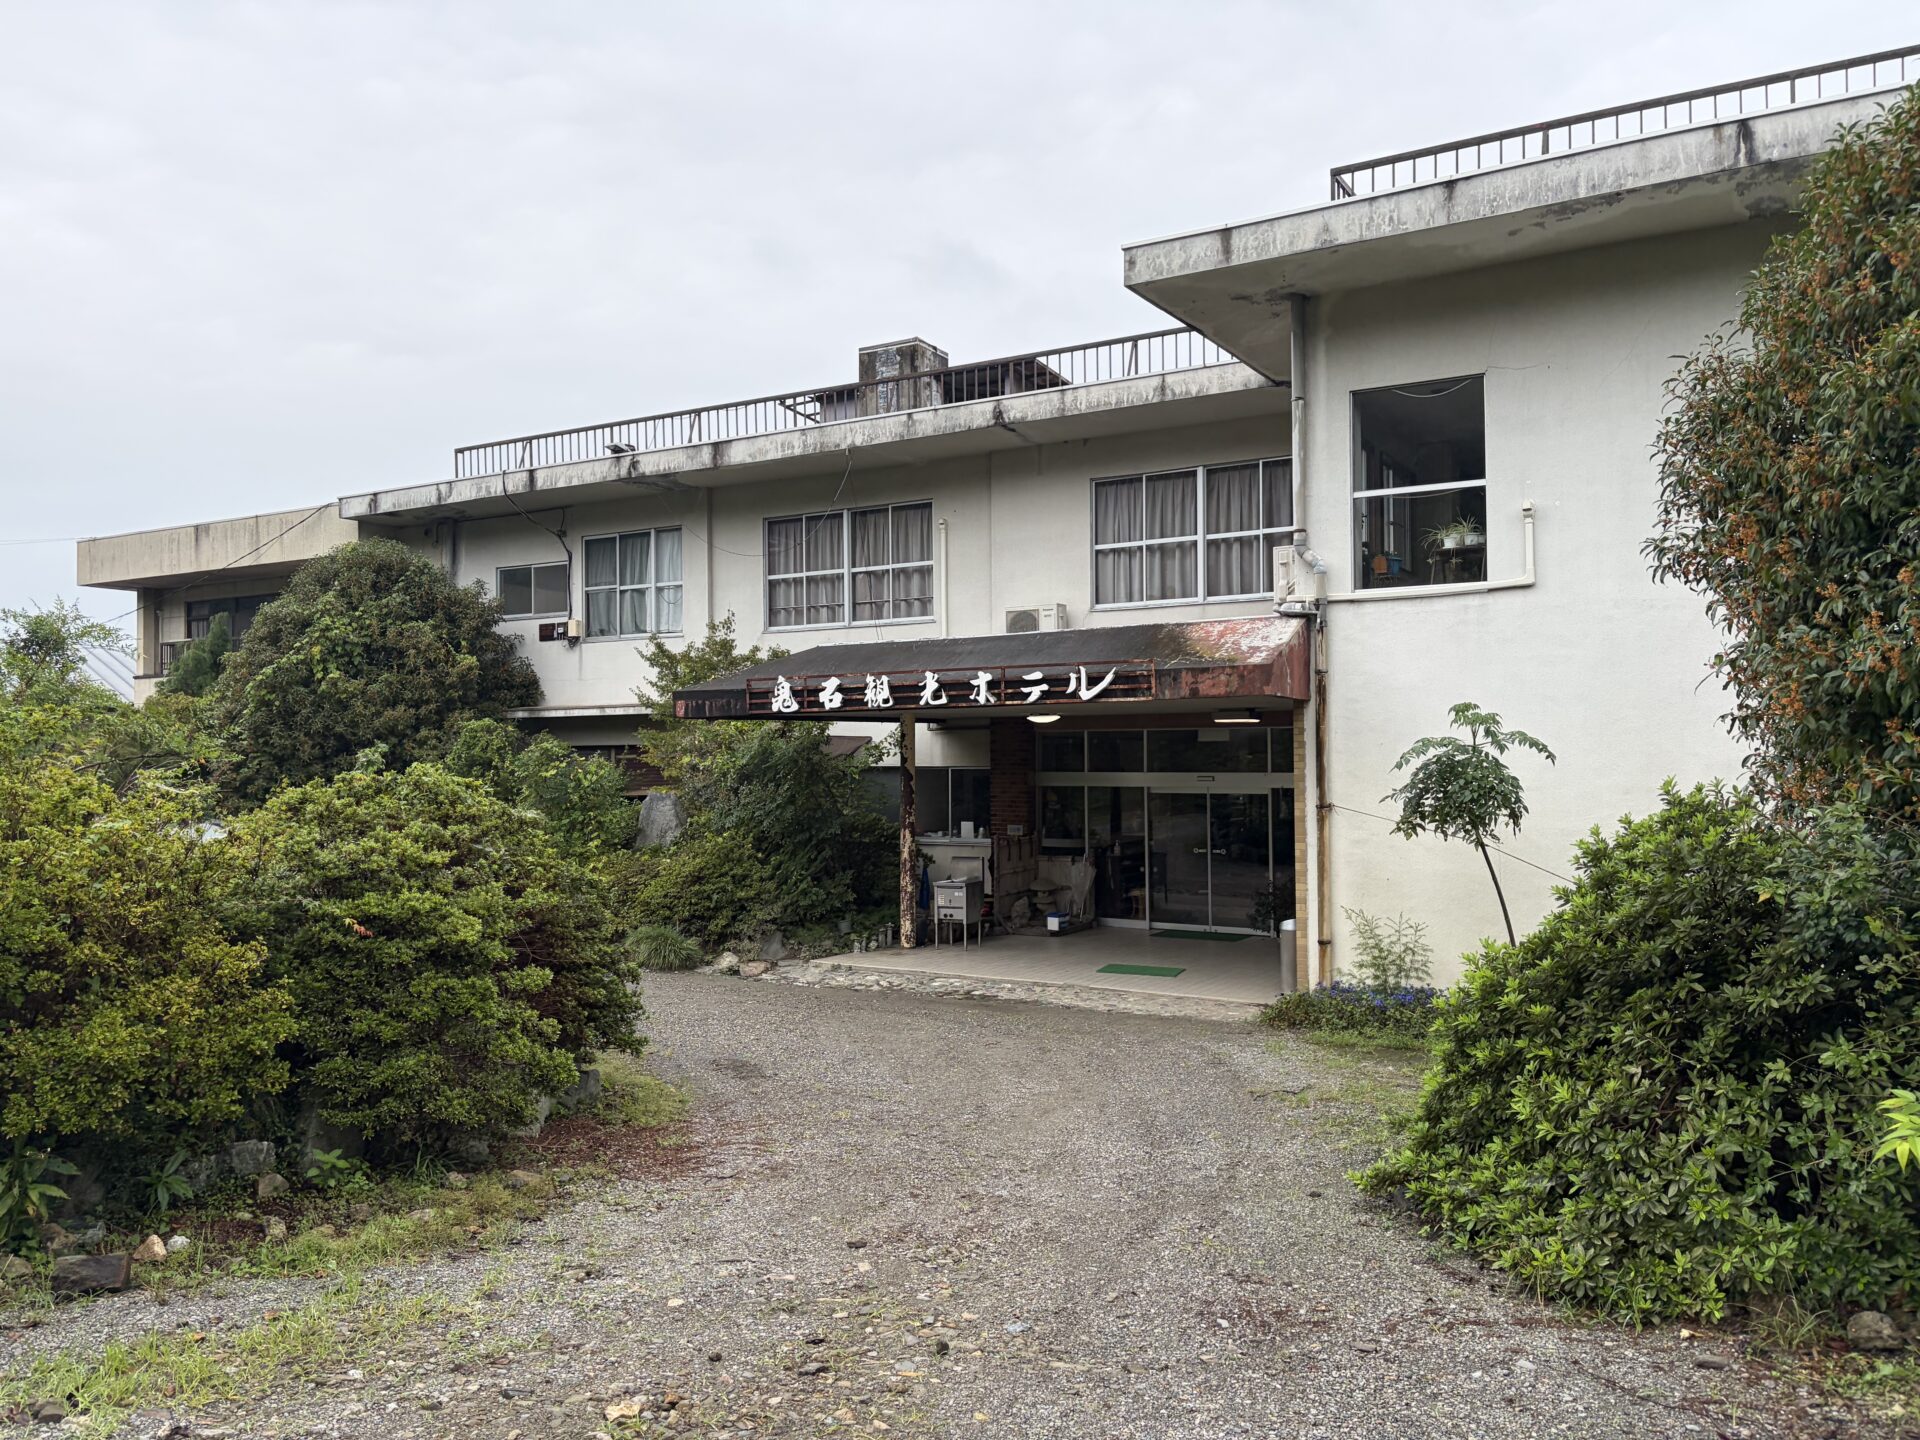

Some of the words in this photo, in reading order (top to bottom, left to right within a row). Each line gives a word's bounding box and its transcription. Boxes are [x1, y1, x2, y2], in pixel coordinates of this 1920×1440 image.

[771, 666, 1116, 713] 鬼石観光ホテル
